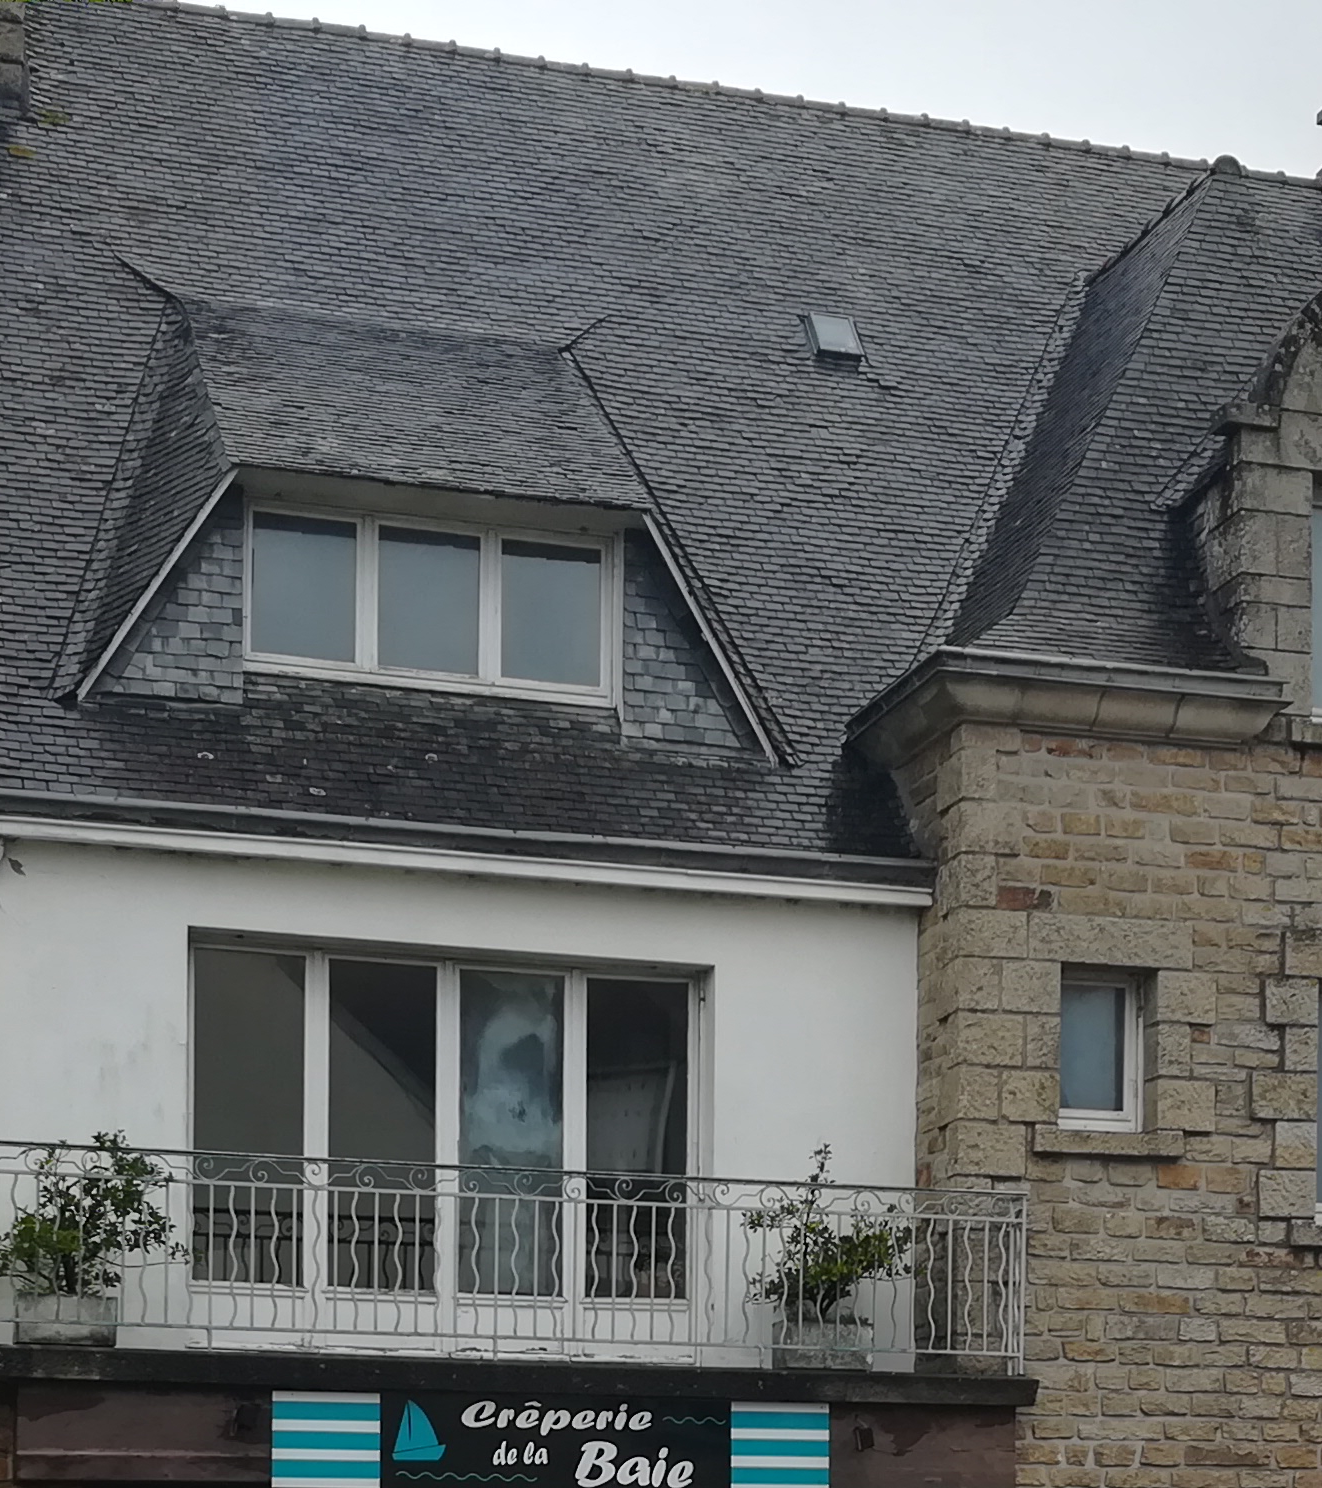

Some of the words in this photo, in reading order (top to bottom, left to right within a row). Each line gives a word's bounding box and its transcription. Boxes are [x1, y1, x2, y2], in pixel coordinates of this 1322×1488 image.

[461, 1400, 653, 1436] Crêperie
[492, 1441, 518, 1465] de
[523, 1441, 549, 1465] la
[575, 1440, 695, 1488] Baie
